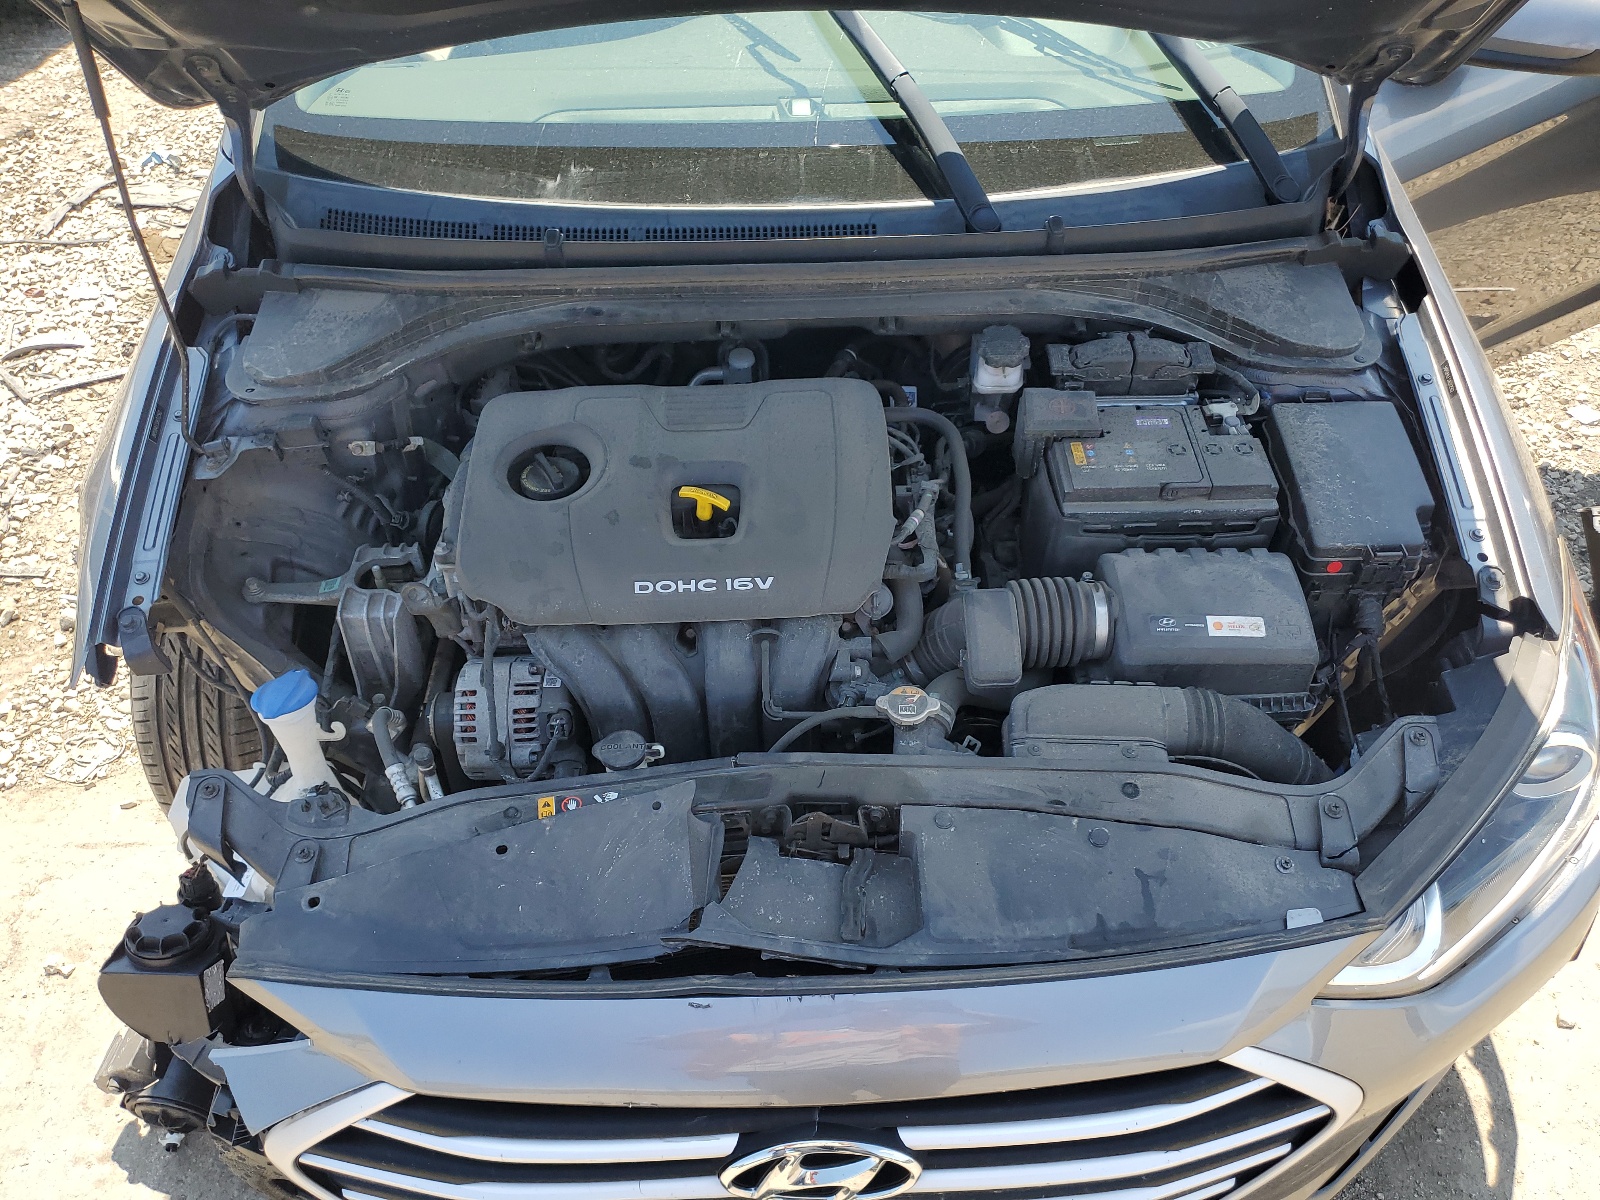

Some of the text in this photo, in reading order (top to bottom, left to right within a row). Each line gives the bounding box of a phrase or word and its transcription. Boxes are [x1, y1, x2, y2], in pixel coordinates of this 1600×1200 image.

[634, 576, 775, 594] DOHC 16V
[601, 743, 645, 751] COOLANT
